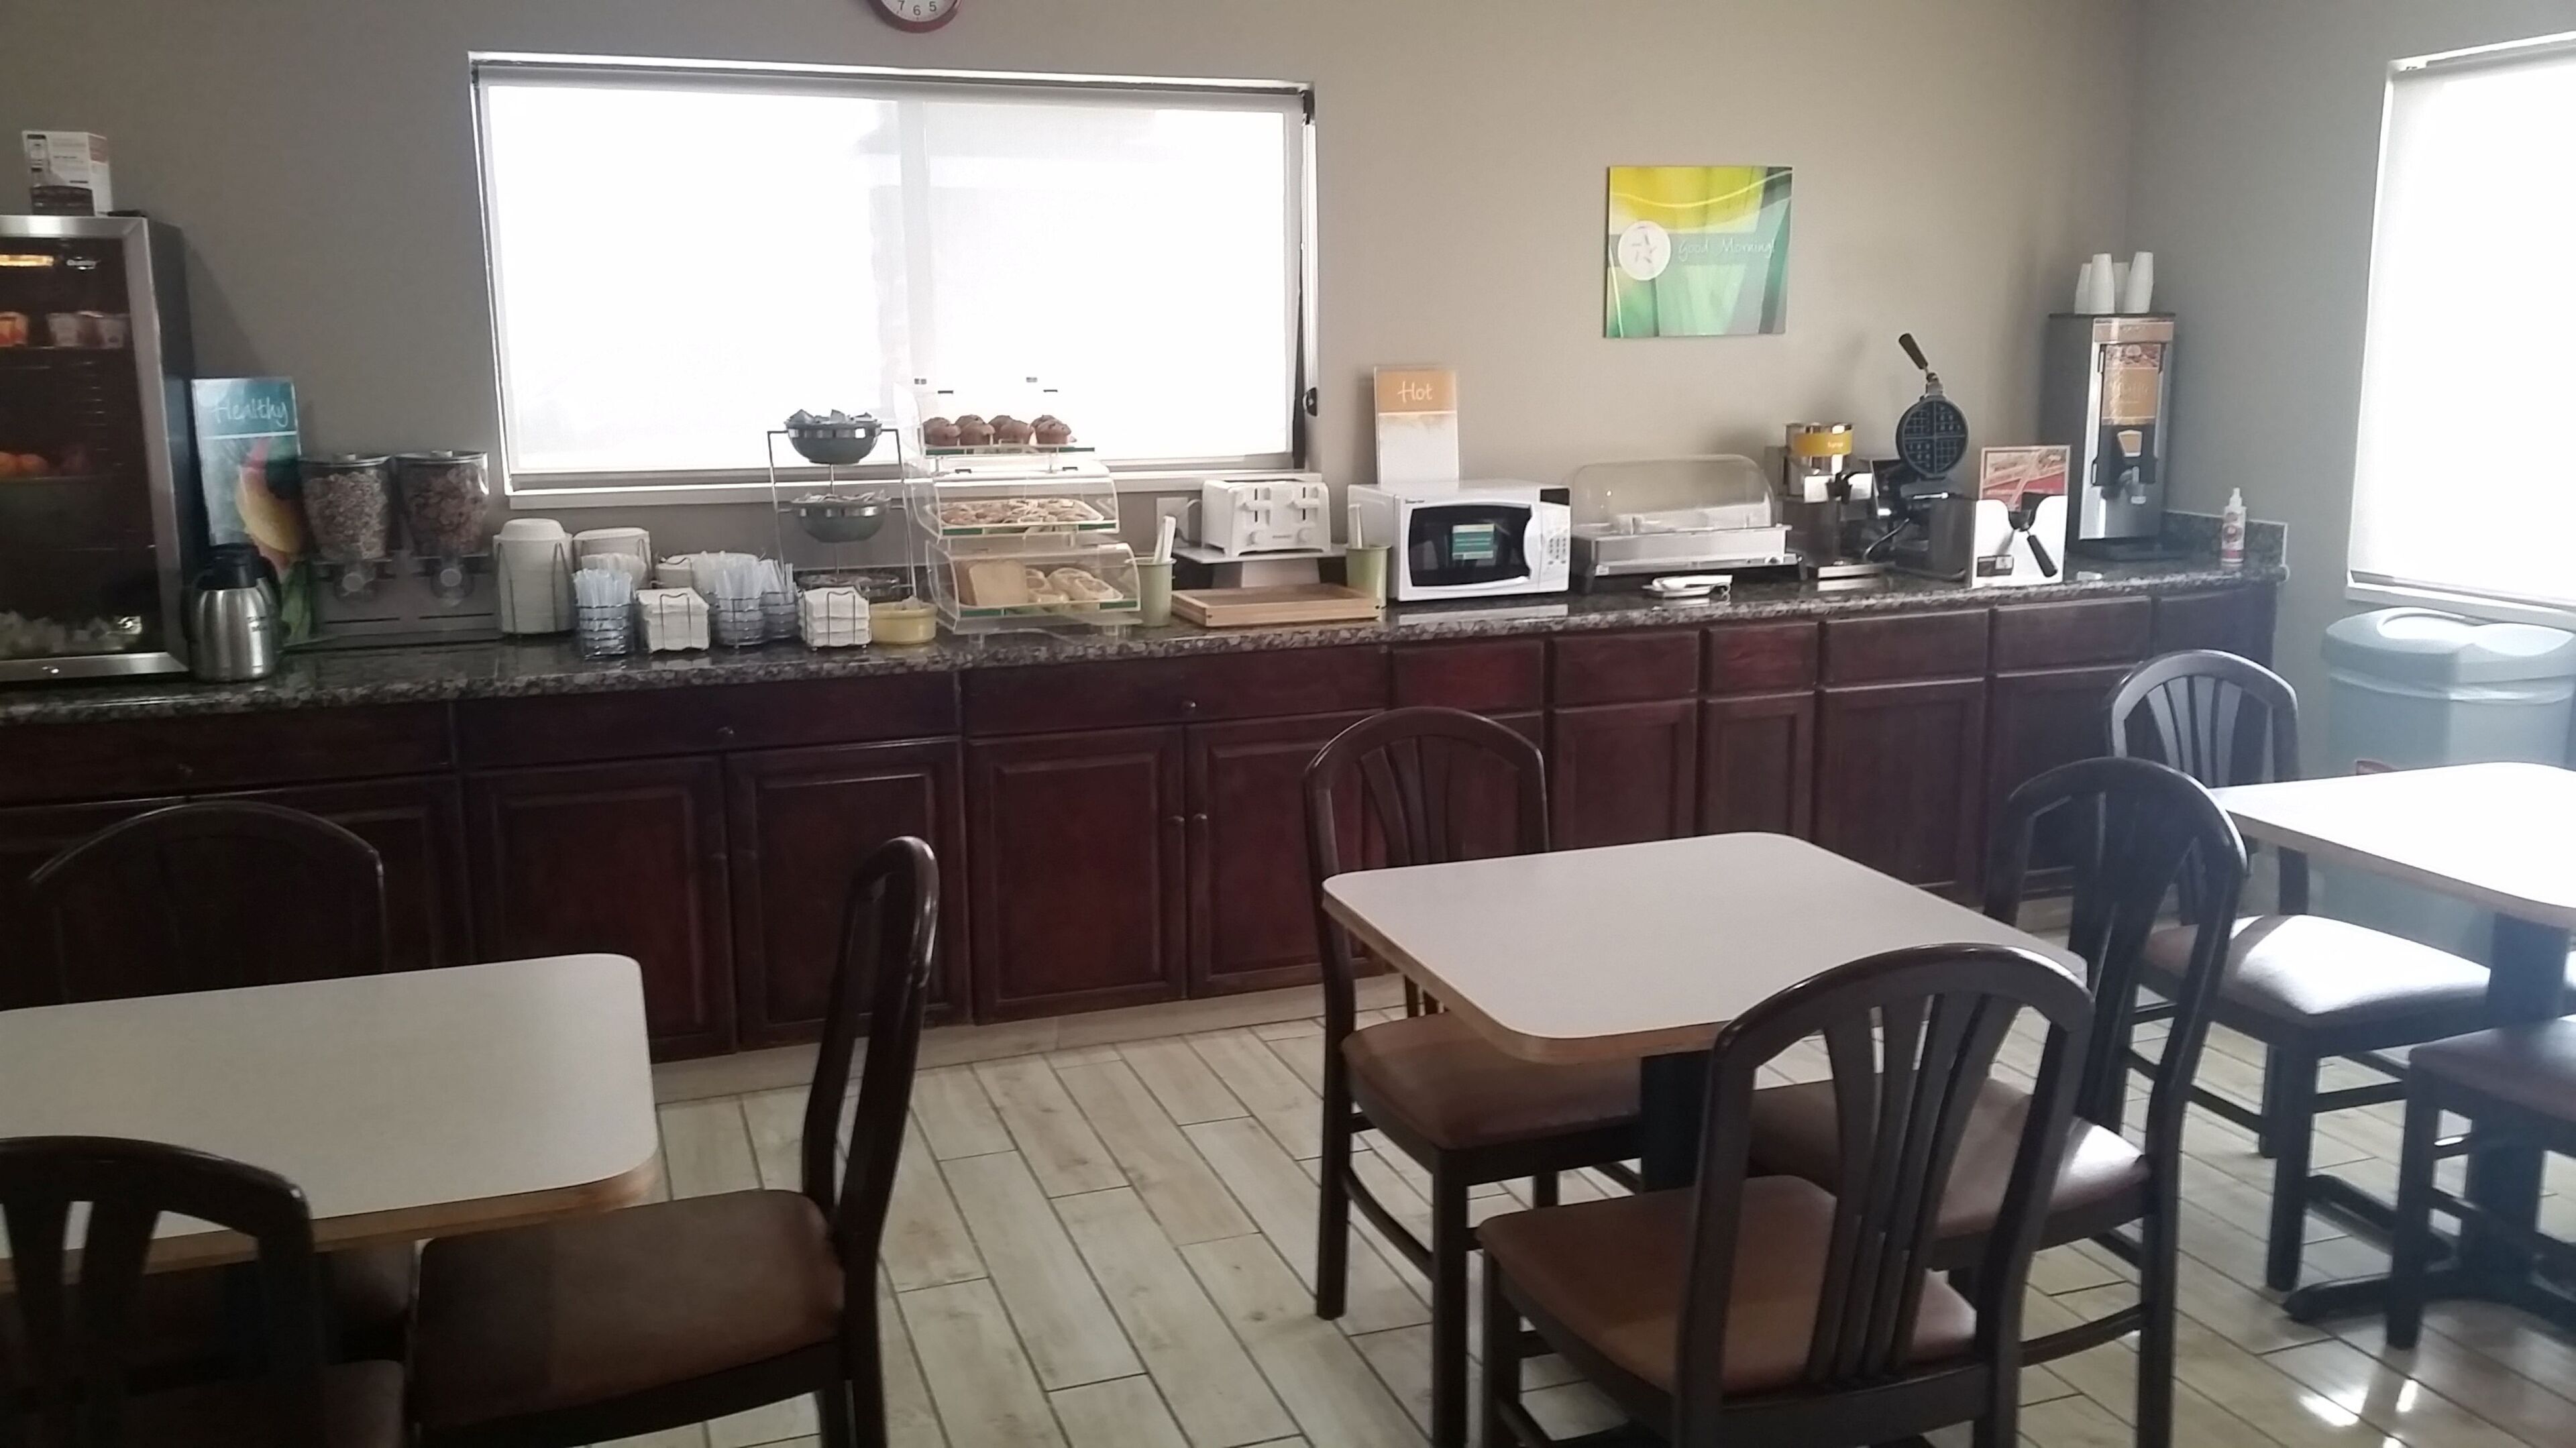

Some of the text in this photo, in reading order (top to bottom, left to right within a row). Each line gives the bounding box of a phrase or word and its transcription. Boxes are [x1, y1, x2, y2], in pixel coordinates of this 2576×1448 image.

[898, 0, 905, 11] 7
[912, 5, 921, 16] 6
[928, 1, 937, 12] 5
[1397, 380, 1433, 403] Hot
[211, 396, 288, 428] Healthy
